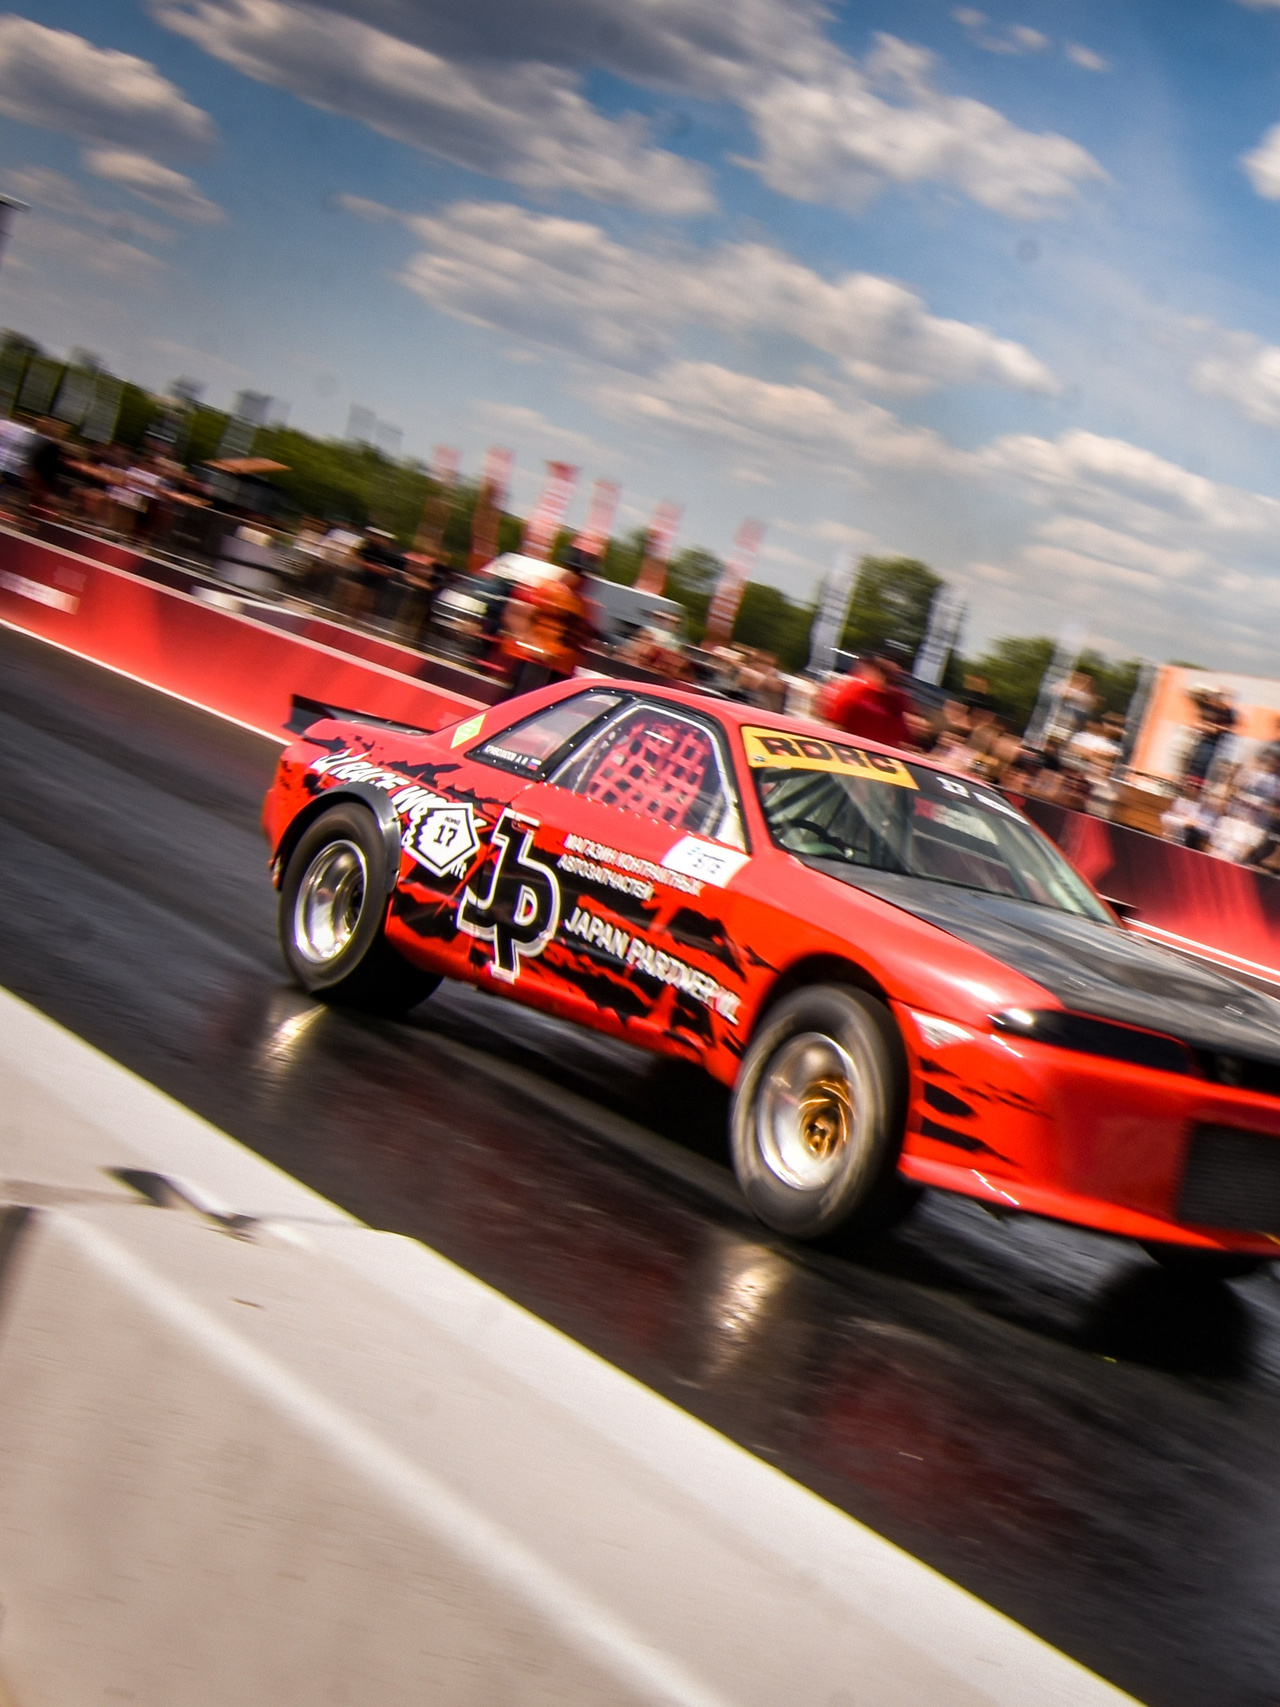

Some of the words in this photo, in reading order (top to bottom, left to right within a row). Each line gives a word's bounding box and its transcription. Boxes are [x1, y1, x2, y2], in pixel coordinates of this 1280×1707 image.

[752, 736, 898, 775] RDRC
[432, 824, 458, 847] 17
[564, 906, 630, 960] JAPAN
